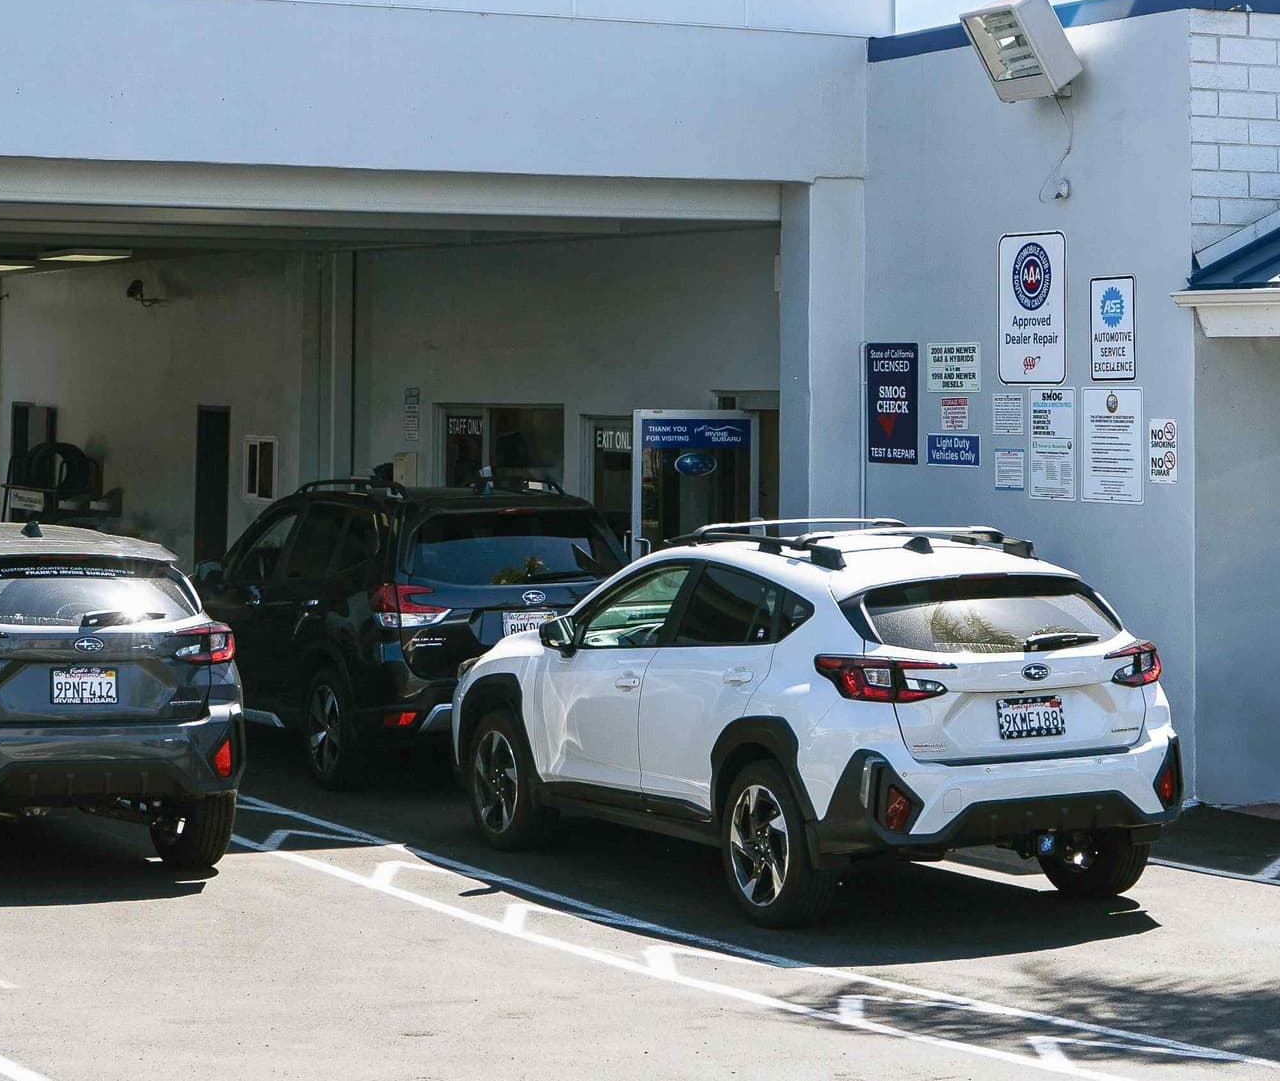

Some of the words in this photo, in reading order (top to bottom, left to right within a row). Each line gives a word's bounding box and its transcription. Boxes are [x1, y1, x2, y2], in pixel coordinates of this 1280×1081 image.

[1016, 245, 1040, 270] AUTOMOBILE
[1039, 251, 1049, 270] CLUB
[1023, 266, 1041, 283] AAA
[1014, 275, 1031, 307] SOUTHERN
[1031, 274, 1050, 307] CALIFORNIA
[1103, 300, 1121, 313] ASE
[1012, 314, 1051, 329] Approved
[1005, 332, 1031, 345] Dealer
[1033, 332, 1059, 347] Repair
[1094, 332, 1132, 343] AUTOMOTIVE
[870, 349, 883, 359] State
[884, 350, 890, 359] of
[890, 349, 914, 359] California
[956, 346, 977, 354] NEWER
[1100, 347, 1126, 357] SERVICE
[933, 355, 943, 363] GAS
[873, 360, 910, 372] LICENSED
[1094, 361, 1133, 372] EXCELLENCE
[878, 386, 906, 399] SMOG
[1041, 392, 1063, 401] SMOG
[876, 401, 909, 414] CHECK
[449, 418, 467, 435] STAFF
[468, 419, 484, 435] ONLY
[648, 425, 672, 433] THANK
[597, 431, 613, 449] EXIT
[615, 431, 632, 450] ONL
[1151, 429, 1164, 440] NO
[936, 437, 953, 450] Light
[954, 437, 970, 450] Duty
[1151, 440, 1176, 449] SMOKING
[870, 447, 886, 457] TEST
[887, 448, 891, 458] &
[893, 448, 915, 459] REPAIR
[931, 450, 959, 461] Vehicles
[960, 450, 976, 464] Only
[1151, 457, 1164, 469] NO
[1151, 469, 1170, 477] FUMAR
[55, 681, 113, 699] 9PNF412
[1003, 710, 1060, 732] 9KME188
